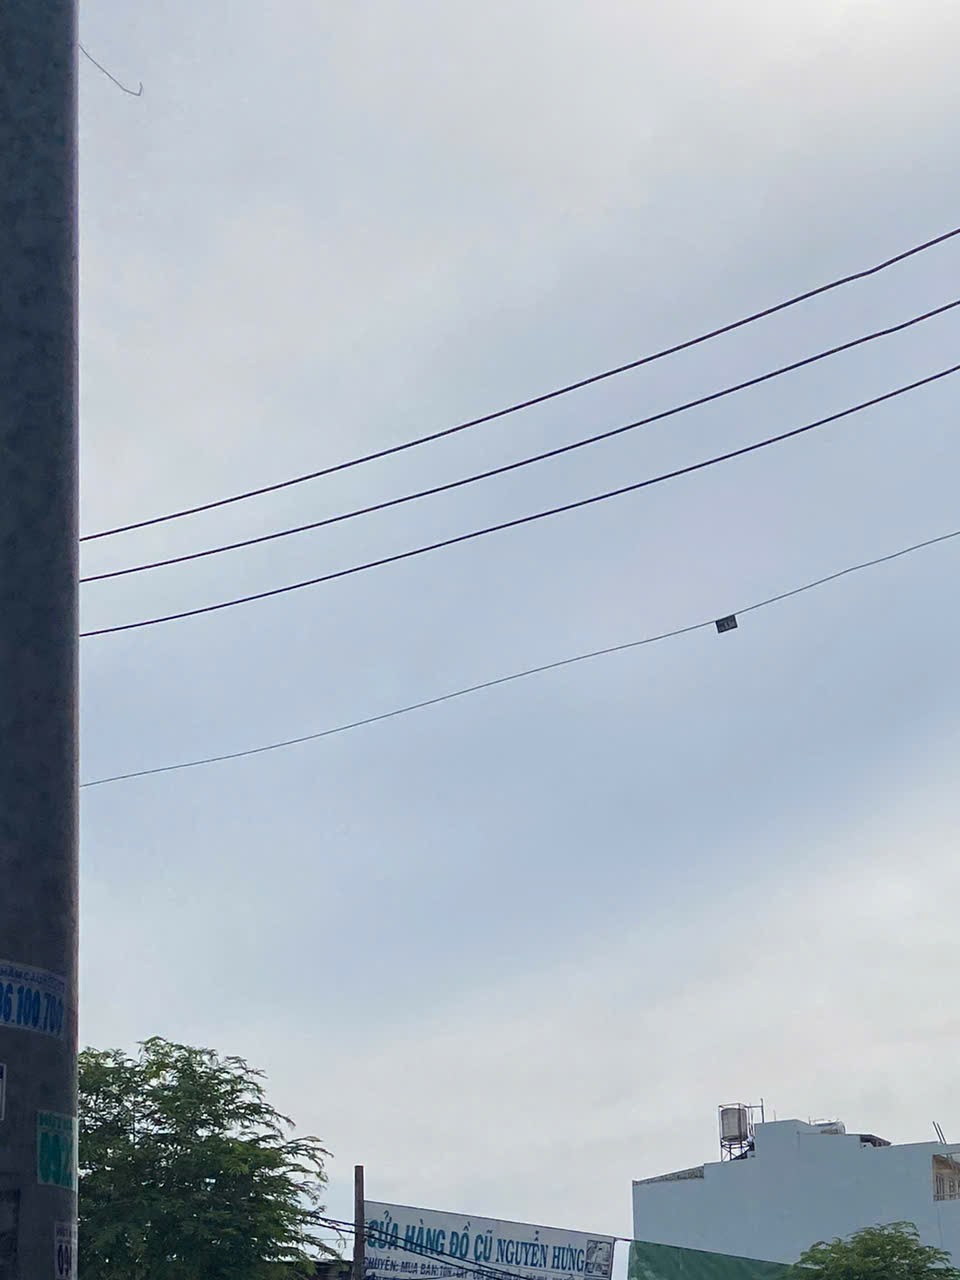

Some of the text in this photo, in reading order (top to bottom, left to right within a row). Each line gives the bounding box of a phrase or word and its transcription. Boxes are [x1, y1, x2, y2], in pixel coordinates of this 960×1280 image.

[367, 1210, 399, 1250] CỬA
[404, 1218, 446, 1256] HÀNG
[449, 1221, 470, 1258] ĐỒ
[474, 1229, 493, 1261] CŨ
[551, 1243, 585, 1272] HƯNG
